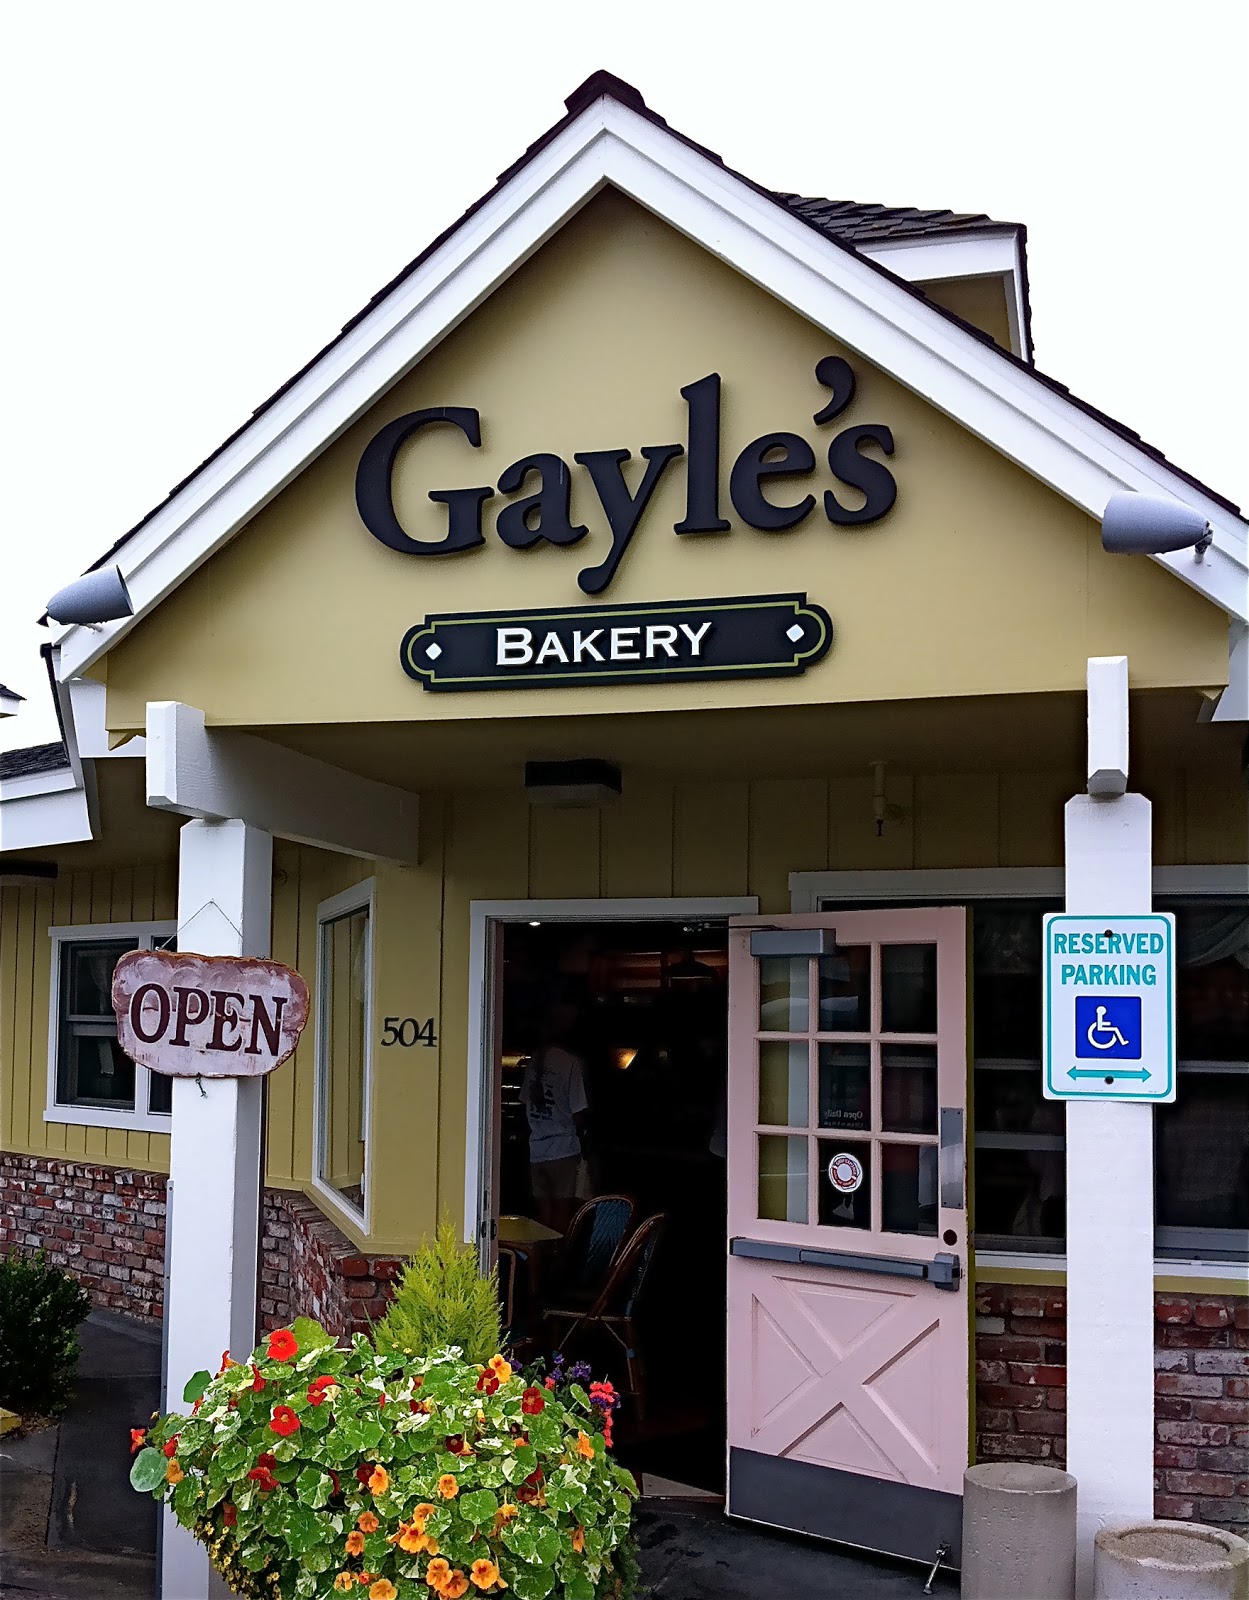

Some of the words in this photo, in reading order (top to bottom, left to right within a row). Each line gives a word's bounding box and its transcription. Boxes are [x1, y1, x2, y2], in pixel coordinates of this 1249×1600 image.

[355, 355, 898, 595] Gayle's
[496, 622, 713, 667] BAKERY
[1054, 933, 1164, 954] RESERVED
[1061, 964, 1157, 985] PARKING
[130, 983, 288, 1056] OPEN
[381, 1017, 437, 1047] 504
